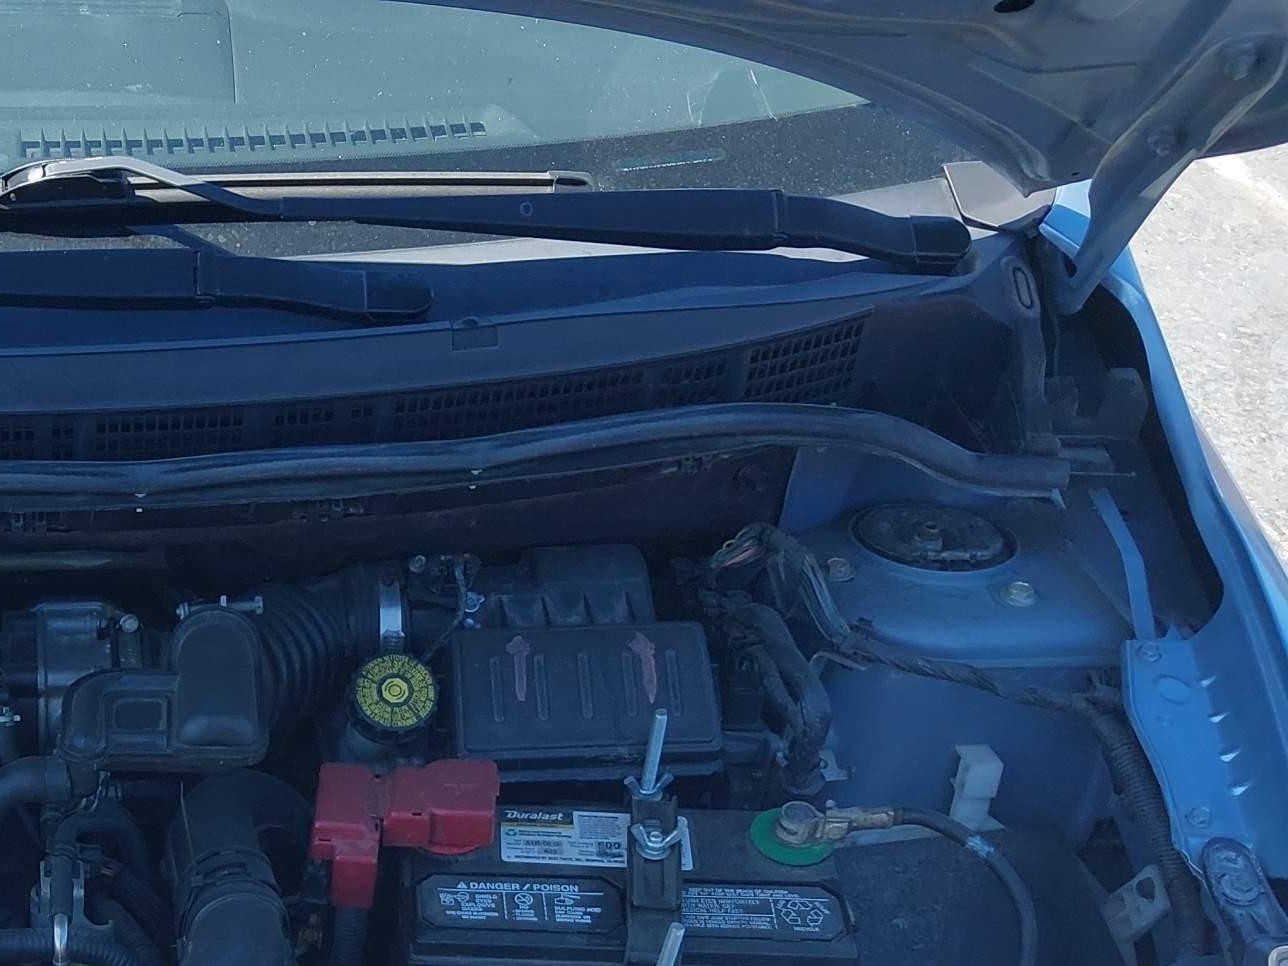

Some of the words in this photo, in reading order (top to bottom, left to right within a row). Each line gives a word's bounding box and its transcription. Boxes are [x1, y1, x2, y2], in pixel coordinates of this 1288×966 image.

[505, 809, 564, 821] Duralast
[470, 882, 520, 891] DANGER
[533, 884, 579, 892] POISON
